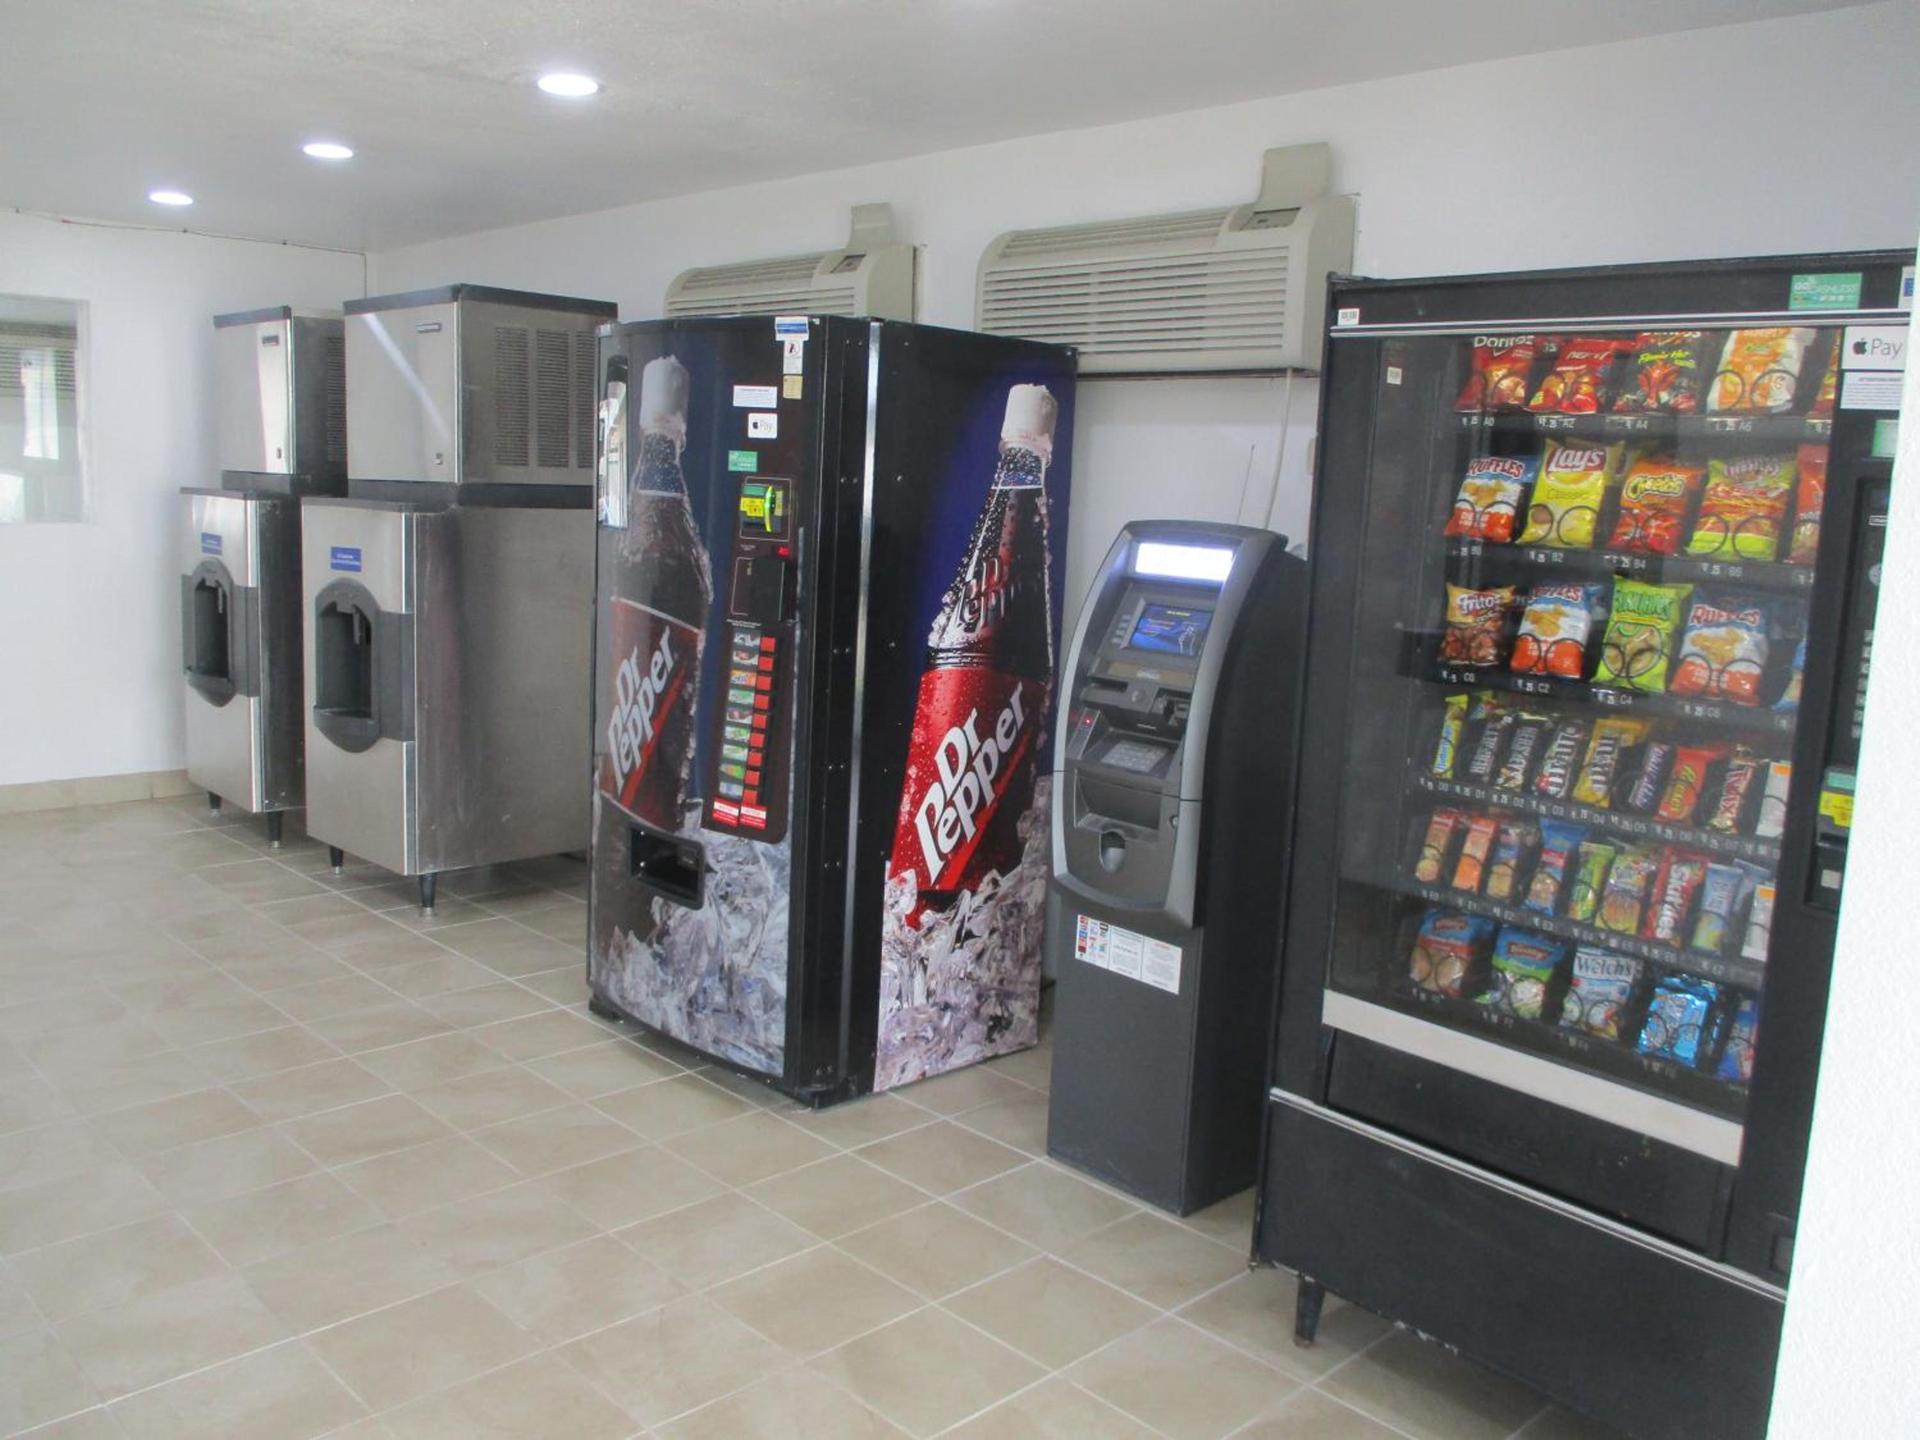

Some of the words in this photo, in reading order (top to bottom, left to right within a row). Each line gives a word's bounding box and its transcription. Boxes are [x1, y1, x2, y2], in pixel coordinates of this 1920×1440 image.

[1870, 338, 1903, 360] Pay
[1469, 457, 1526, 480] RUFFLES
[1547, 447, 1604, 471] Lay's
[615, 645, 641, 723] Dr
[608, 625, 675, 796] Pepper
[934, 707, 978, 799] Dr
[914, 681, 1024, 886] Pepper
[1576, 955, 1633, 979] Welch's
